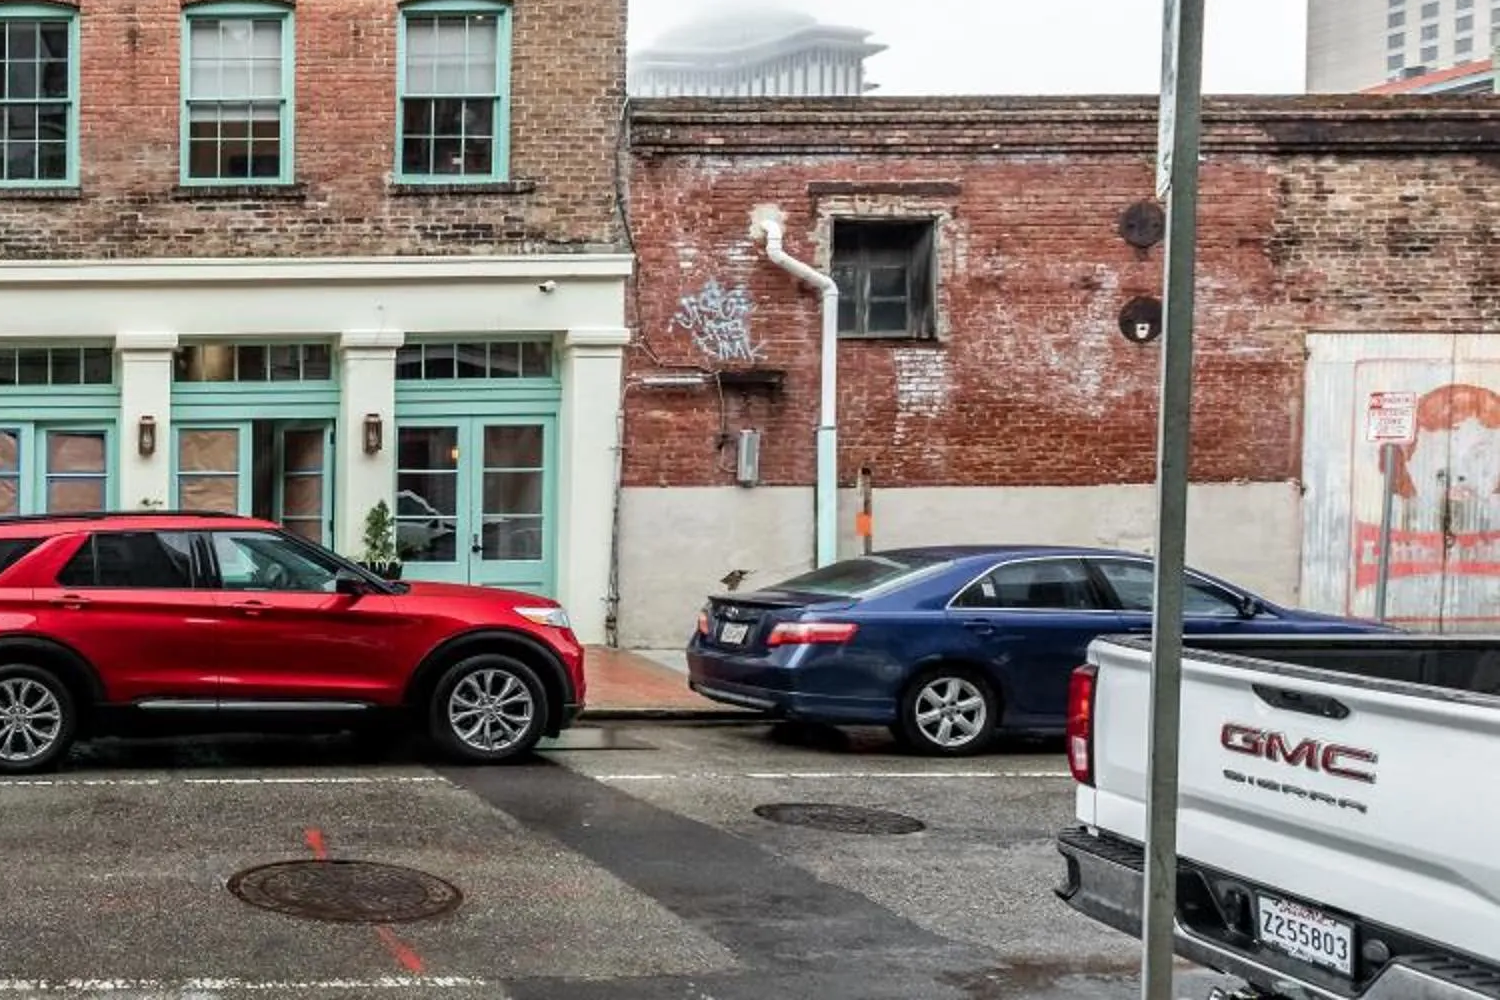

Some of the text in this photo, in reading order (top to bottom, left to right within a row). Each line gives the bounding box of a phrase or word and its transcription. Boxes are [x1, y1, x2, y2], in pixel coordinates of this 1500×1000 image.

[1221, 723, 1378, 784] GMC
[1223, 769, 1368, 814] SIERRA
[1261, 909, 1348, 961] Z255803
